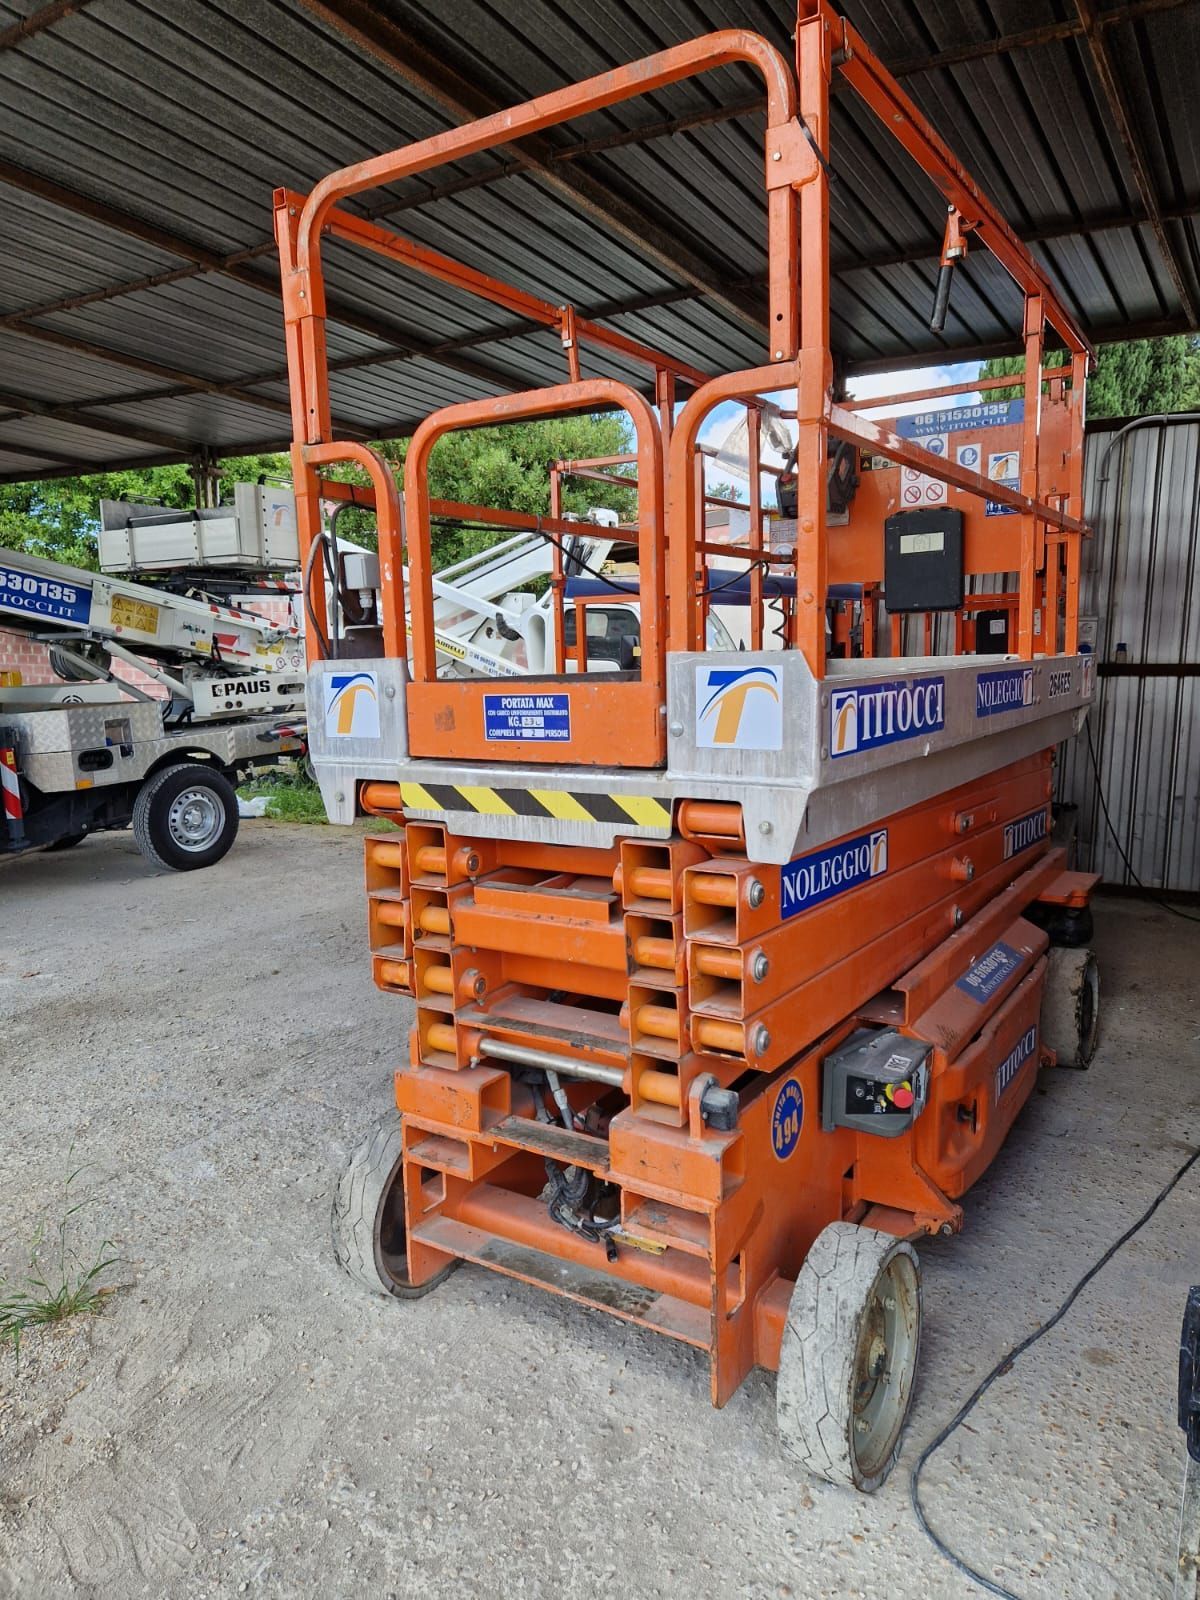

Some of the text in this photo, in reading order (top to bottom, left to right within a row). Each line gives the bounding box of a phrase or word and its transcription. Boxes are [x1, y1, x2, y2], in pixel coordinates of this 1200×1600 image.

[914, 402, 1010, 426] 06 51530135
[915, 416, 1009, 435] WWW.TITOCCI.IT
[223, 679, 271, 696] PAUS
[977, 677, 1024, 709] NOLEGGIO
[501, 697, 554, 709] PORTATA MAX
[859, 683, 944, 741] TITOCCI
[489, 729, 515, 737] COMPRESE
[545, 729, 569, 738] PERSONE
[508, 716, 521, 728] KG.
[1014, 811, 1046, 850] TITOCCI
[783, 844, 870, 908] NOLEGGIO
[965, 973, 982, 987] 06
[1001, 1028, 1035, 1089] TITOCCI
[775, 1108, 799, 1150] 494
